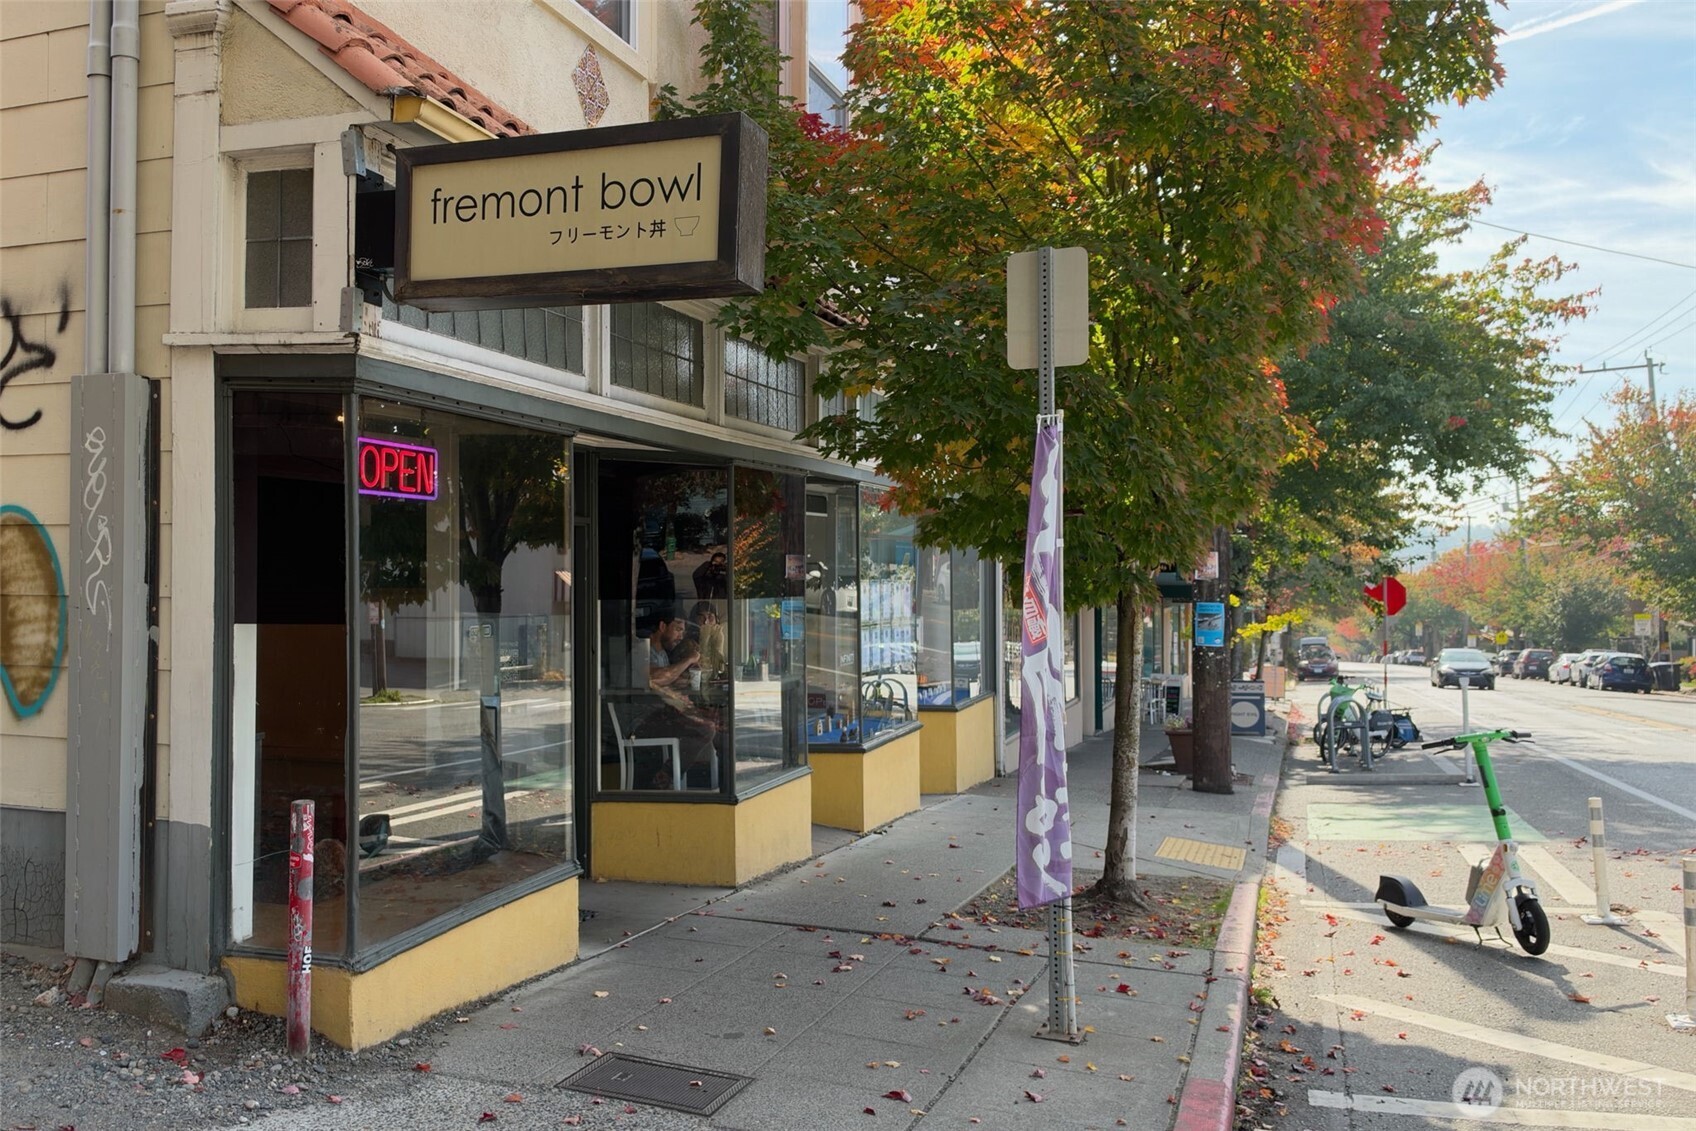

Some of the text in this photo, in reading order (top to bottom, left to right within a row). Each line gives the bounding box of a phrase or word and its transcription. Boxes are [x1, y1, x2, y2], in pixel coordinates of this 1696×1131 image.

[431, 162, 702, 225] fremont bowl
[550, 219, 667, 245] フリーモント丼
[360, 445, 434, 494] OPEN
